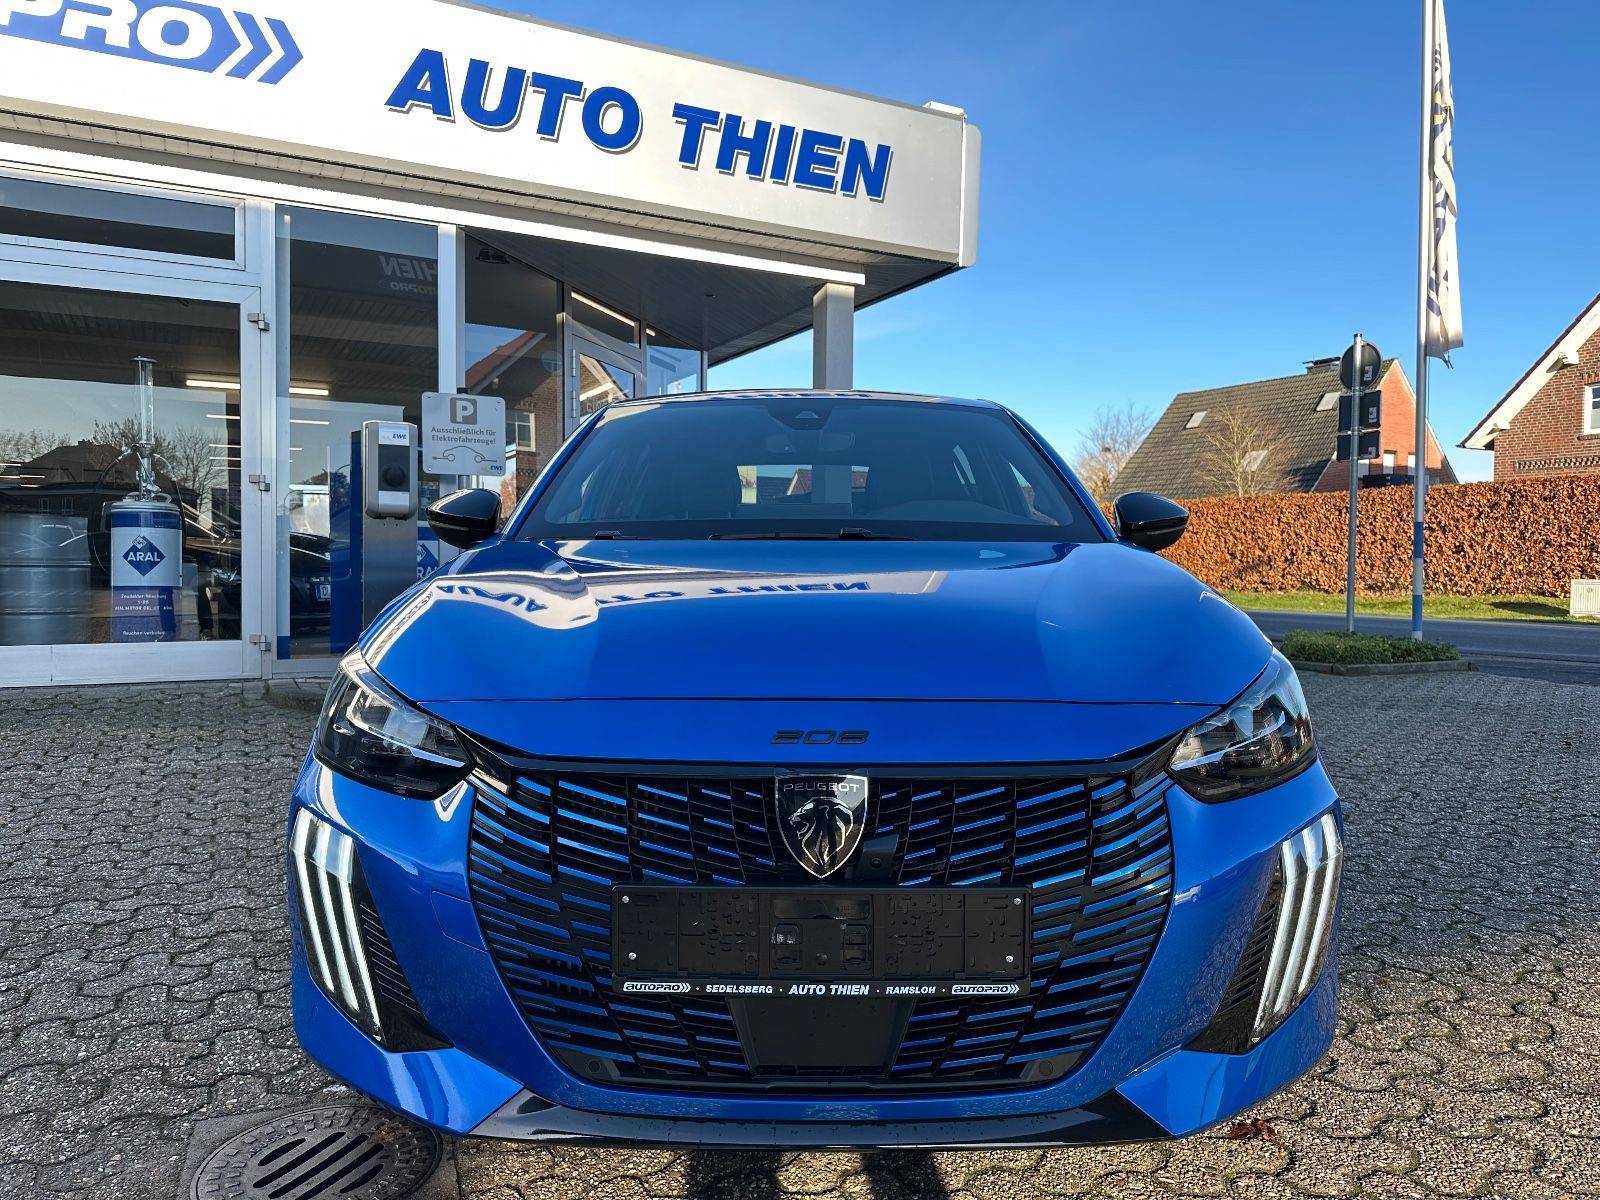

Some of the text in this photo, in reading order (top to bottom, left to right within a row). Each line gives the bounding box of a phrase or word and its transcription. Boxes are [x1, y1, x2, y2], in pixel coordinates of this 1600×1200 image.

[384, 47, 894, 203] AUTO THIEN
[456, 401, 474, 422] P
[431, 427, 497, 437] Ausschließlich für
[127, 551, 161, 562] ARAL
[769, 729, 869, 744] 208
[783, 782, 860, 792] PEUGEOT
[705, 984, 773, 994] SEDELSBERG
[788, 984, 826, 995] AUTO
[830, 984, 870, 995] THIEN
[885, 986, 936, 994] RAMSLOH
